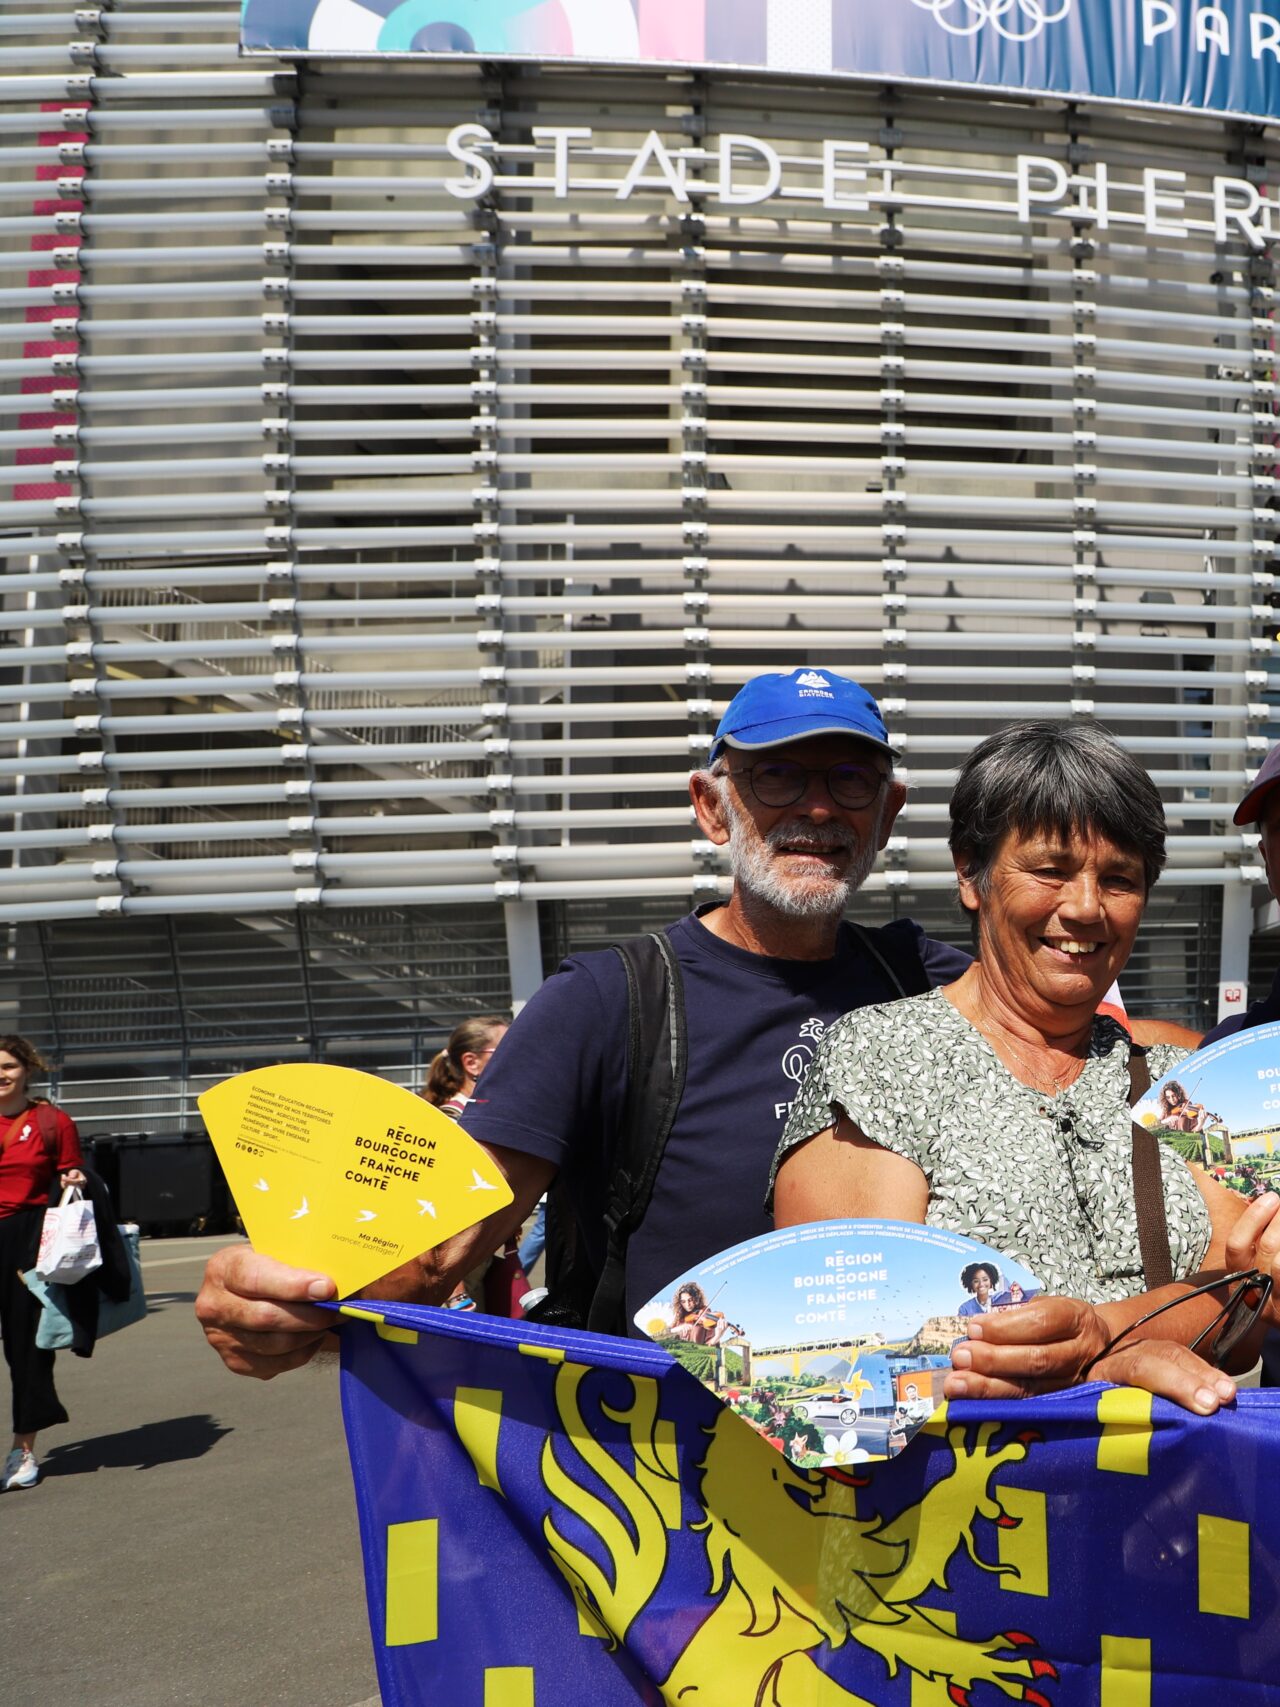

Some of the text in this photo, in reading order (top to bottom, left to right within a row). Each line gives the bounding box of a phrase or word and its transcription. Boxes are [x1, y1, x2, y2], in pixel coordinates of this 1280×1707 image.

[444, 123, 870, 210] STADE
[355, 1136, 436, 1168] BOURGOGNE
[360, 1156, 420, 1182] FRANCHE
[358, 1233, 399, 1250] Ma Région
[362, 1243, 395, 1256] partager
[794, 1269, 887, 1288] BOURGOGNE
[807, 1289, 877, 1305] FRANCHE
